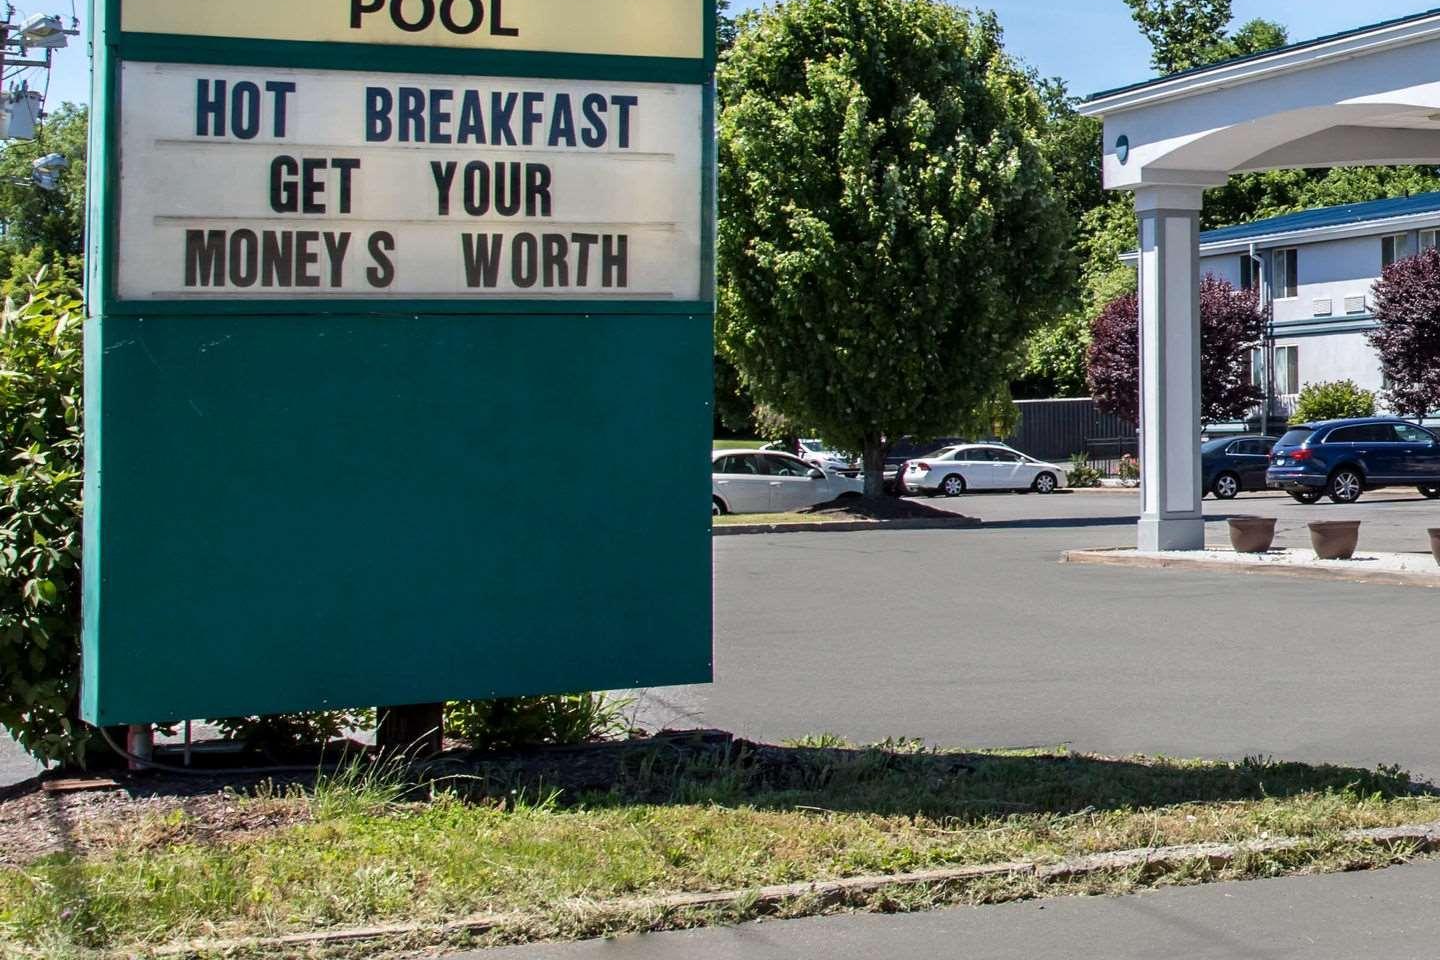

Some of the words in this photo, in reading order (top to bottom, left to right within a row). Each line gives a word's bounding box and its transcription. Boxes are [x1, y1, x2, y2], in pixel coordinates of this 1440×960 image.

[196, 78, 296, 139] HOT
[365, 86, 639, 149] BREAKFAST
[270, 155, 361, 215] GET
[430, 160, 552, 218] YOUR
[461, 232, 628, 289] WORTH
